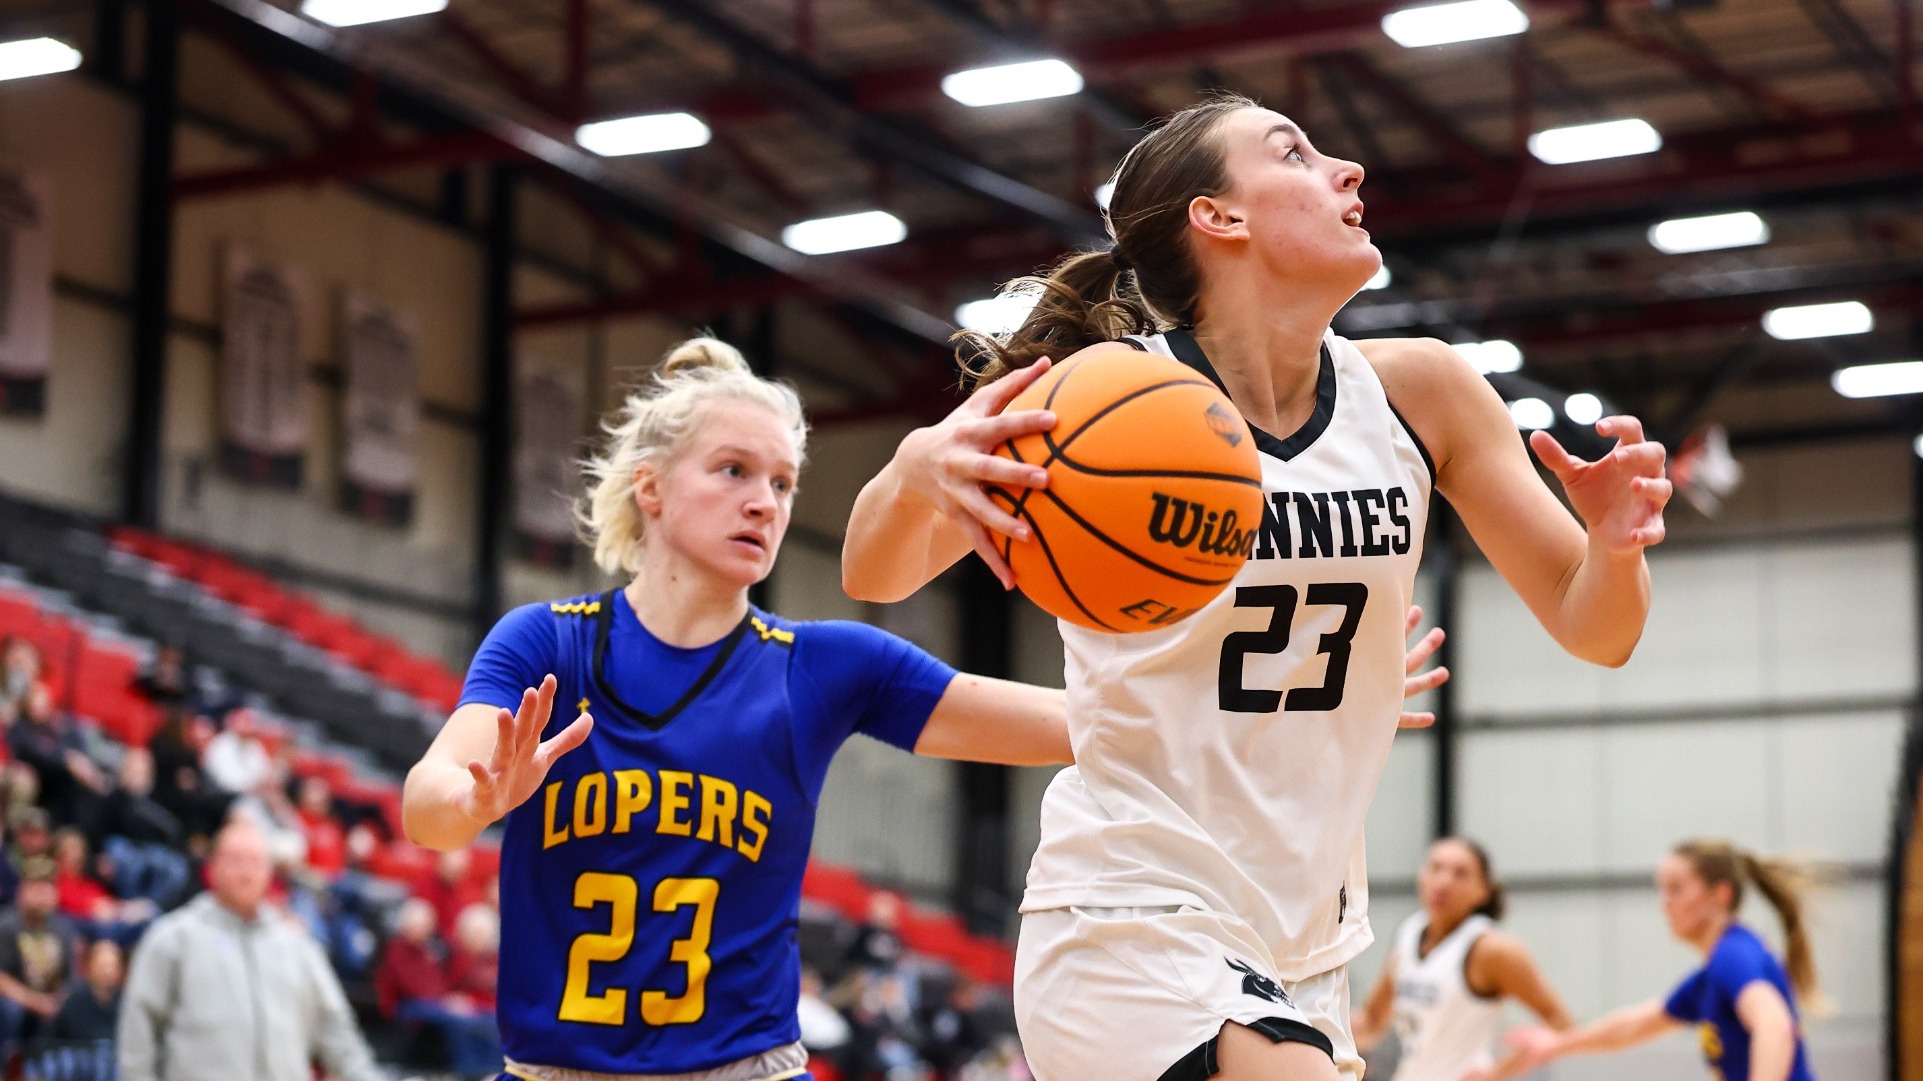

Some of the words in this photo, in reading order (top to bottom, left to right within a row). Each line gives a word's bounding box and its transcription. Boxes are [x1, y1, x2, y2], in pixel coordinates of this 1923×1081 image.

[1247, 486, 1411, 561] NNIES
[1218, 582, 1369, 714] 23
[542, 769, 773, 863] LOPERS
[557, 871, 720, 1026] 23
